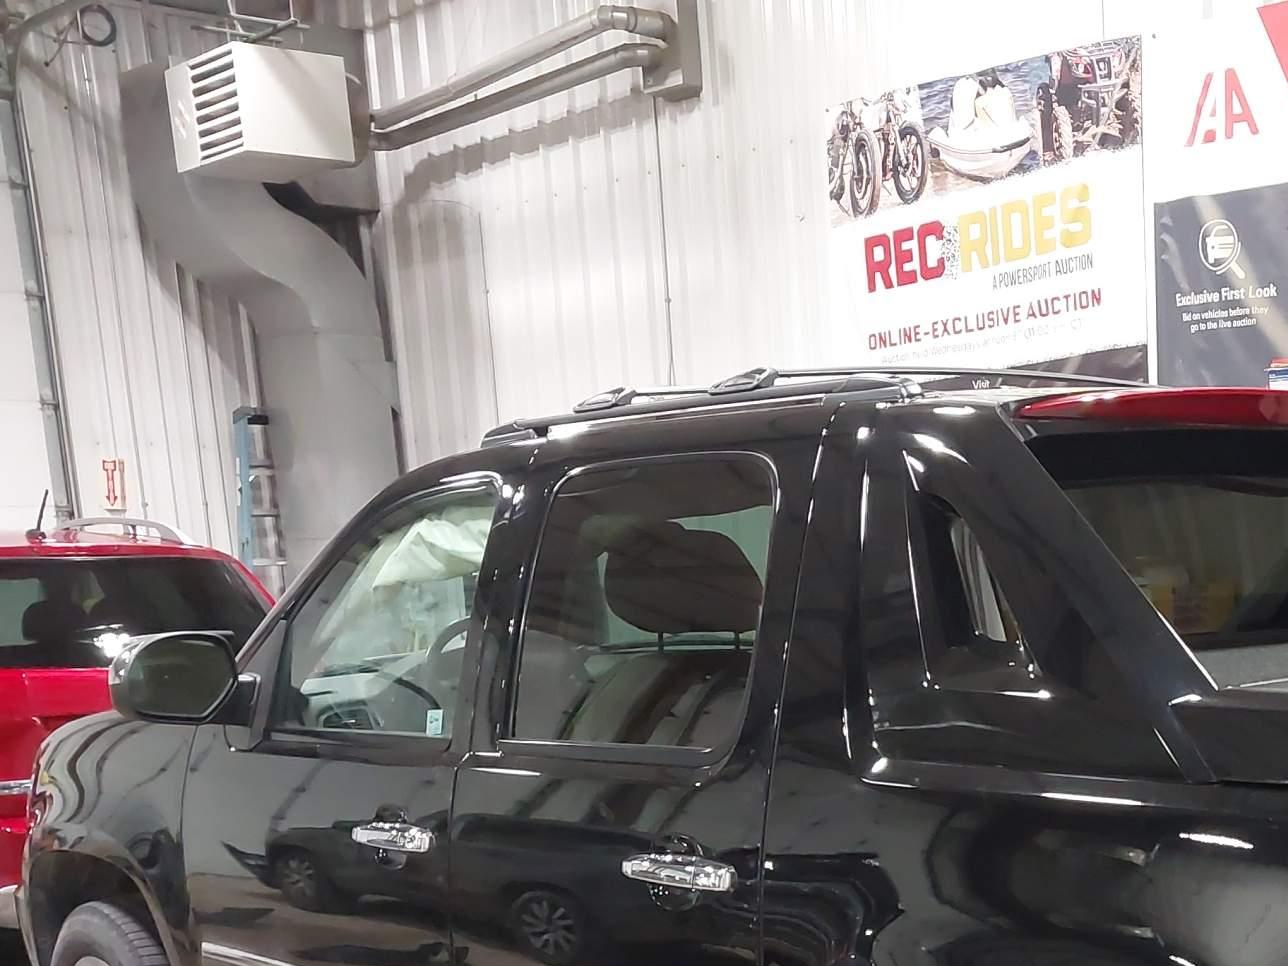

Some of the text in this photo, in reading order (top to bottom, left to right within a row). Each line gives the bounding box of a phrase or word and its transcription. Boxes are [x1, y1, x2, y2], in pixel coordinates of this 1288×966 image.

[863, 183, 1093, 293] REC RIDES
[999, 260, 1052, 288] POWERSPORT
[1055, 253, 1094, 275] AUCTION
[1175, 283, 1278, 307] Exclusive First Look
[868, 305, 1022, 350] ONLINE-EXCLUSIVE
[1026, 287, 1102, 320] AUCTION
[1192, 312, 1201, 321] on
[1201, 308, 1229, 320] vehicles
[1229, 306, 1250, 317] before
[1251, 304, 1269, 315] they
[1199, 322, 1206, 330] to
[1207, 320, 1218, 329] the
[1233, 317, 1257, 327] auction
